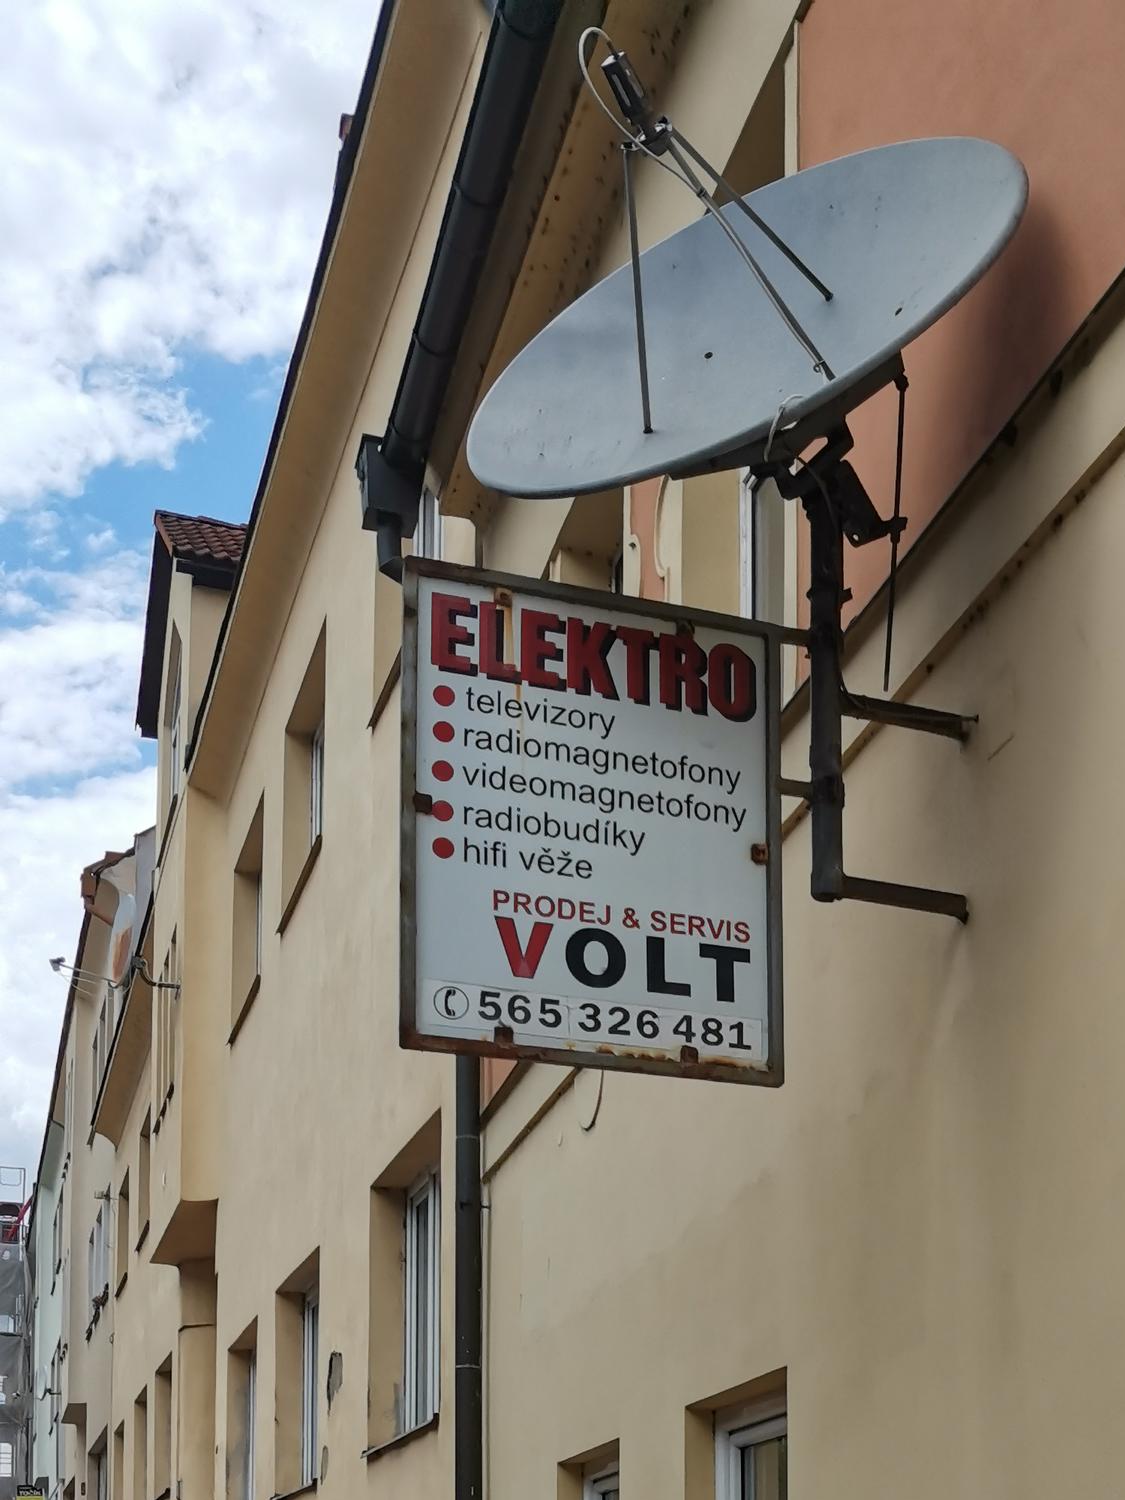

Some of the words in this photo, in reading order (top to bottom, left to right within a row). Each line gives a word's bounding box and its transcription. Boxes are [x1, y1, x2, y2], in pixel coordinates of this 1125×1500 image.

[431, 592, 756, 722] ELEKTRO
[466, 687, 615, 739] televizory
[463, 727, 741, 794] radiomagnetofony
[462, 763, 747, 832] videomagnetofony
[463, 806, 645, 856] radiobudíky
[463, 837, 507, 868] hifi
[519, 849, 593, 879] věže
[492, 890, 611, 926] PRODEJ
[622, 908, 640, 929] &
[650, 911, 751, 944] SERVIS
[494, 915, 751, 1003] VOLT
[478, 990, 562, 1029] 565
[578, 1003, 660, 1039] 326
[672, 1014, 752, 1051] 481
